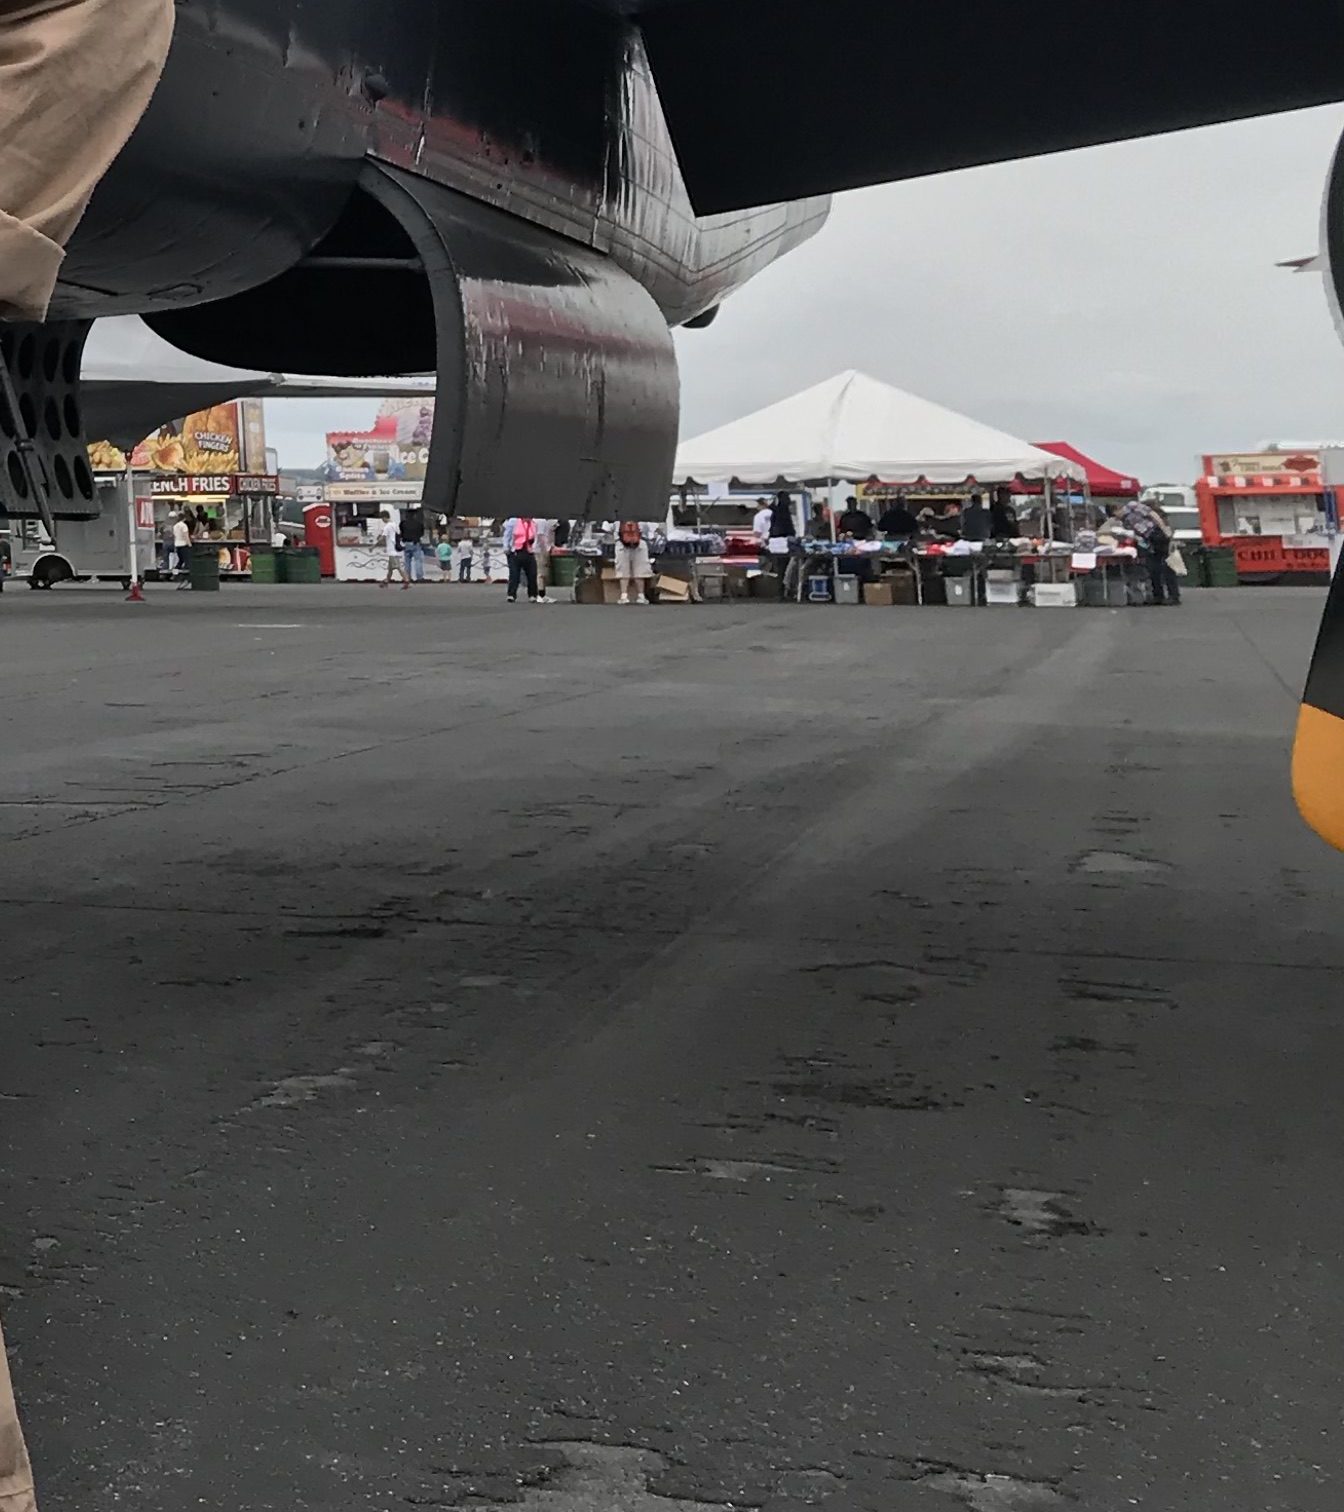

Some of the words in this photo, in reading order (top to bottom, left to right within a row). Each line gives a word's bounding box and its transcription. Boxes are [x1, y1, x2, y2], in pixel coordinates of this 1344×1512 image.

[194, 430, 232, 444] CHICKEN
[198, 440, 230, 453] FINGERS
[191, 476, 230, 493] FRIES
